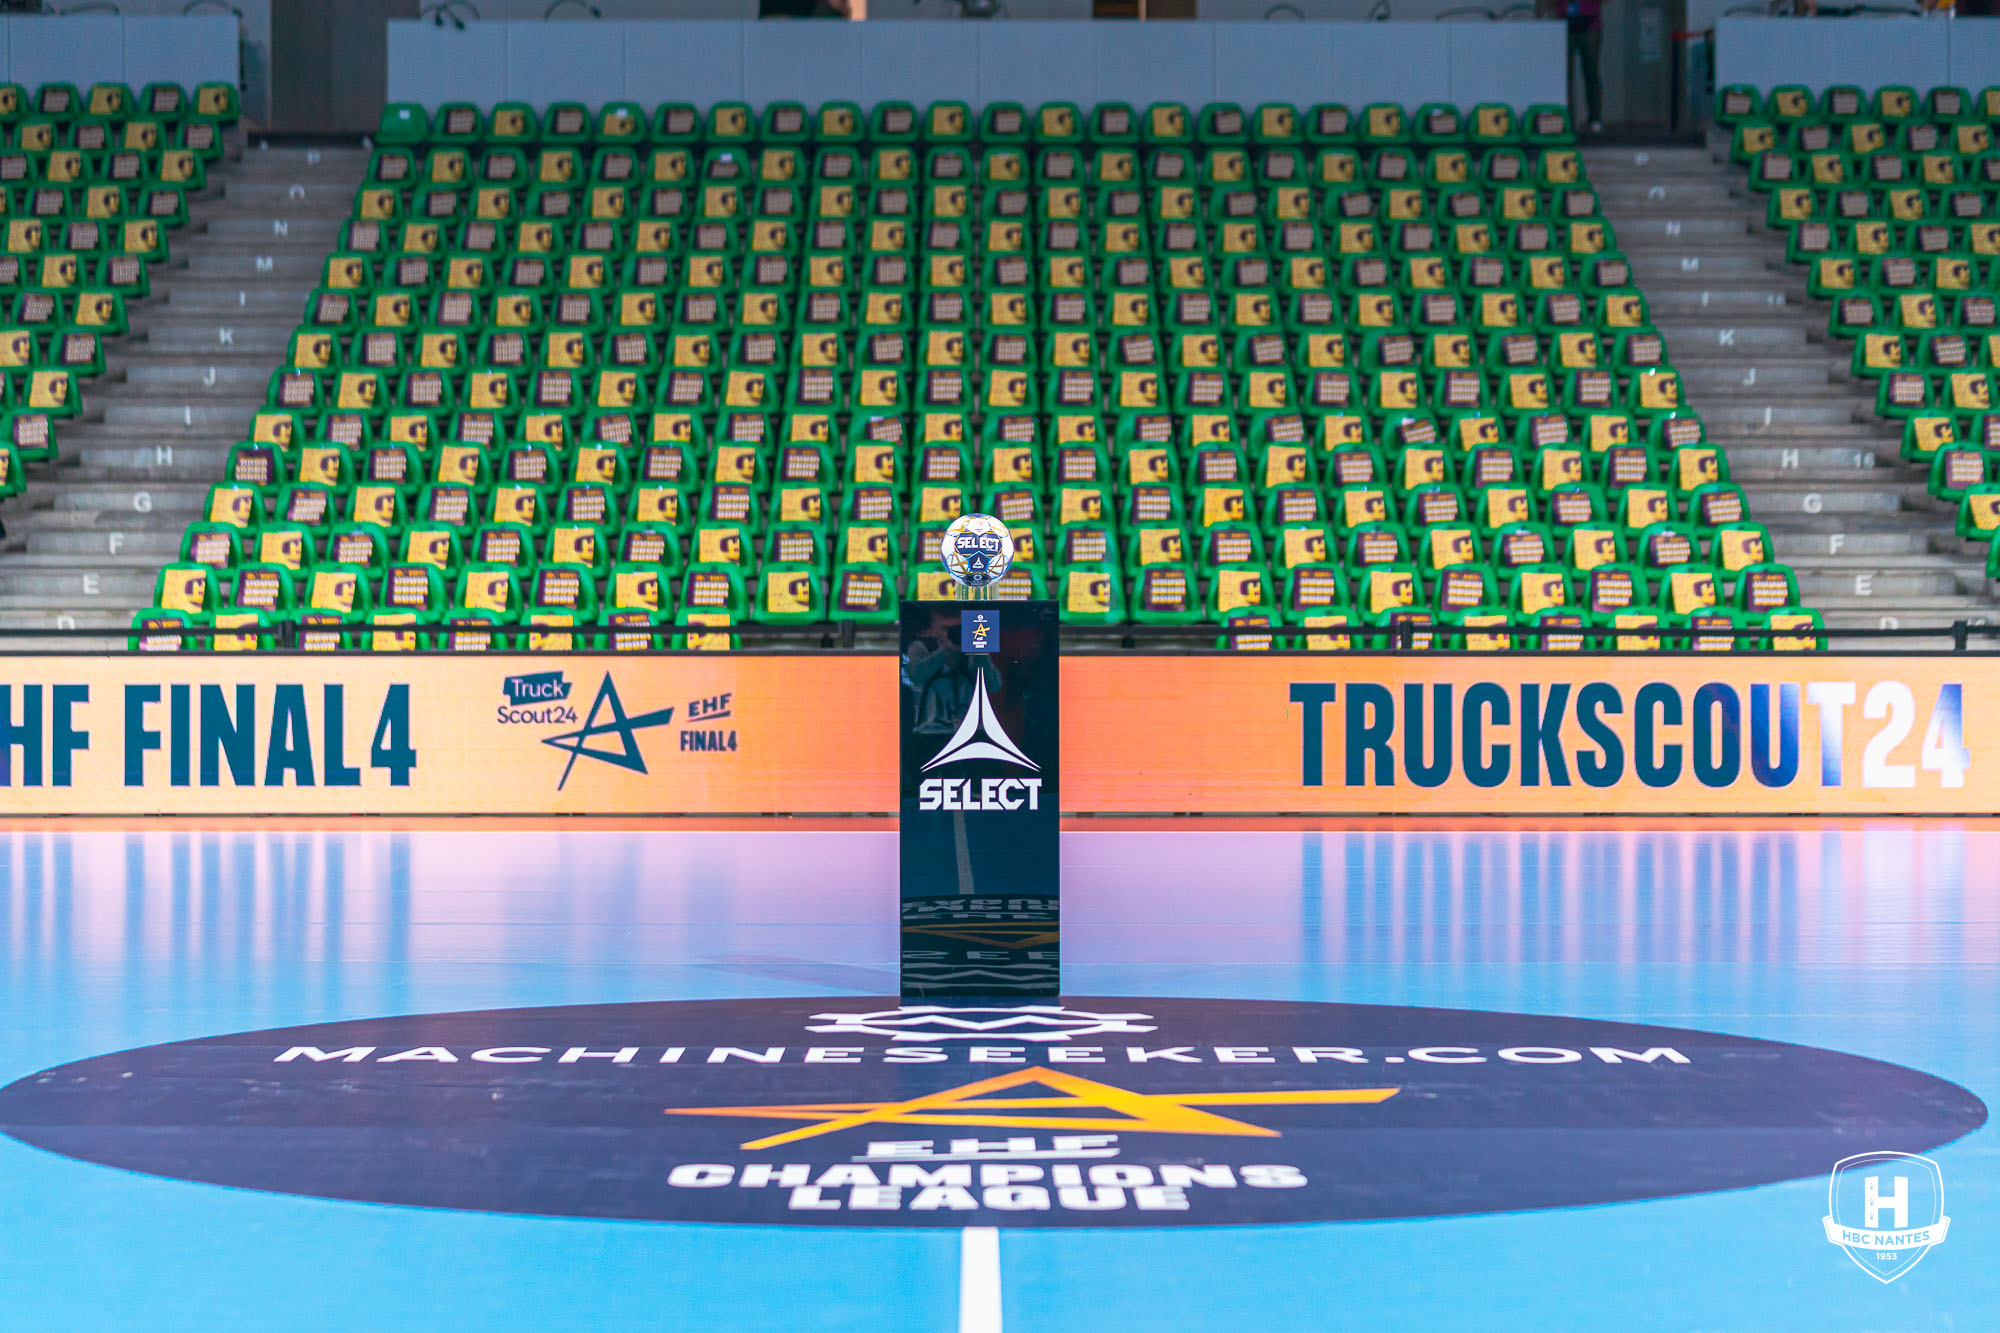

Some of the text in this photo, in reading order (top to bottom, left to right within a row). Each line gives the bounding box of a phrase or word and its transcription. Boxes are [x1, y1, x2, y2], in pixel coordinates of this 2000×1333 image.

[273, 220, 288, 237] N
[256, 256, 273, 271] M
[1681, 257, 1699, 271] M
[219, 328, 234, 344] K
[1719, 328, 1735, 345] K
[204, 367, 216, 386] J
[1743, 368, 1756, 385] J
[184, 406, 192, 425] I
[1764, 406, 1772, 425] I
[156, 446, 173, 465] H
[1782, 449, 1799, 468] H
[133, 491, 152, 512] G
[1803, 493, 1823, 513] G
[109, 532, 124, 554] F
[957, 536, 1000, 552] SELECT
[1829, 533, 1845, 554] F
[83, 572, 100, 594] E
[1855, 575, 1873, 596] E
[511, 678, 565, 698] Truck
[497, 706, 578, 724] Scout24
[688, 693, 732, 717] EHF
[124, 684, 417, 787] FINAL4
[680, 730, 737, 752] FINAL4
[1289, 682, 1971, 788] TRUCKSCOUT24
[919, 778, 1042, 810] SELECT
[273, 1046, 1691, 1064] MACHINESEEKER.COM
[867, 1134, 1119, 1158] EHF
[667, 1164, 1308, 1188] CHAMPIONS
[788, 1185, 1190, 1211] LEAGUE
